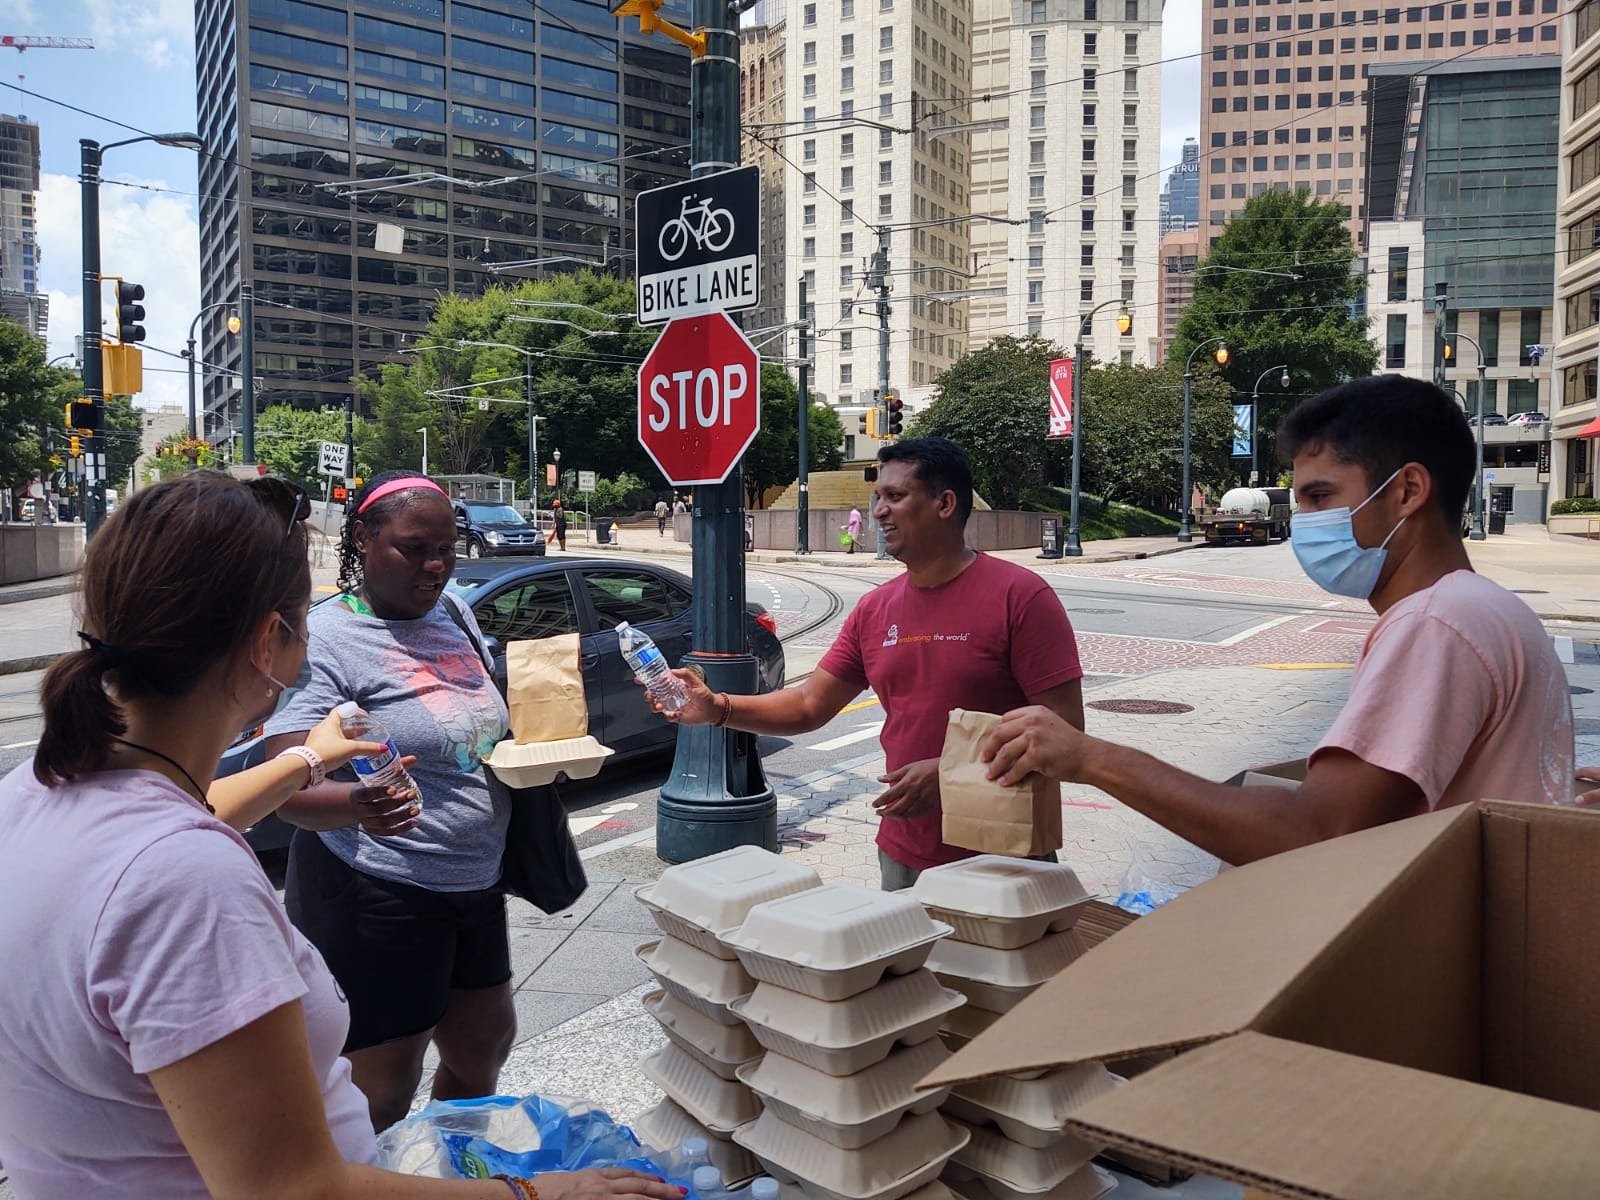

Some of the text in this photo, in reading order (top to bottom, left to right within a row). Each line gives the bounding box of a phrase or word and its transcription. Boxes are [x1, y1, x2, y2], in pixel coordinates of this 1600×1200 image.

[643, 264, 753, 313] BIKE LANE
[648, 363, 748, 432] STOP
[324, 444, 345, 455] ONE
[323, 453, 344, 464] WAY
[933, 632, 944, 641] the
